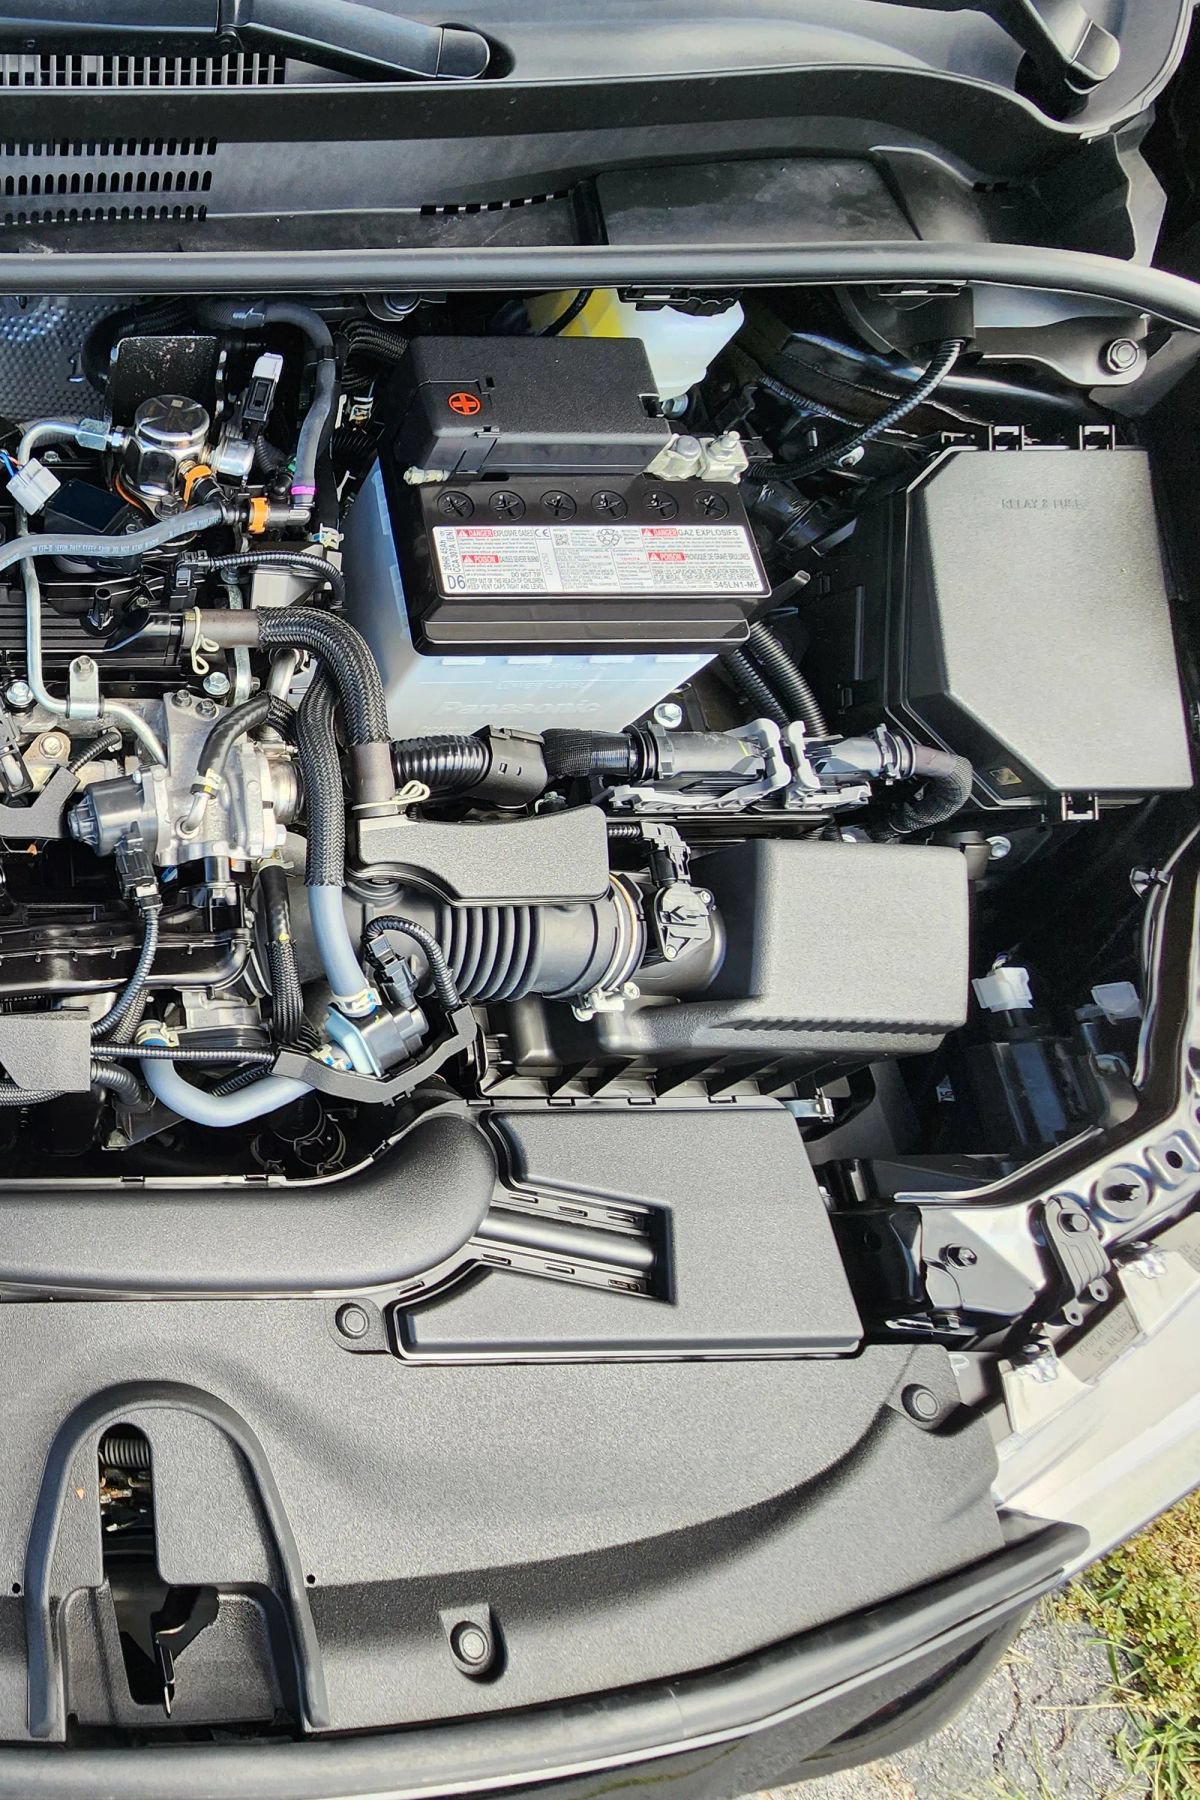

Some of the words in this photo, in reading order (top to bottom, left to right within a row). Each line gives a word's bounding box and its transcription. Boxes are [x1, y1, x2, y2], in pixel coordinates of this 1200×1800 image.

[678, 529, 693, 537] GAZ
[696, 529, 739, 537] EXPLOSIFS
[447, 574, 467, 589] D6
